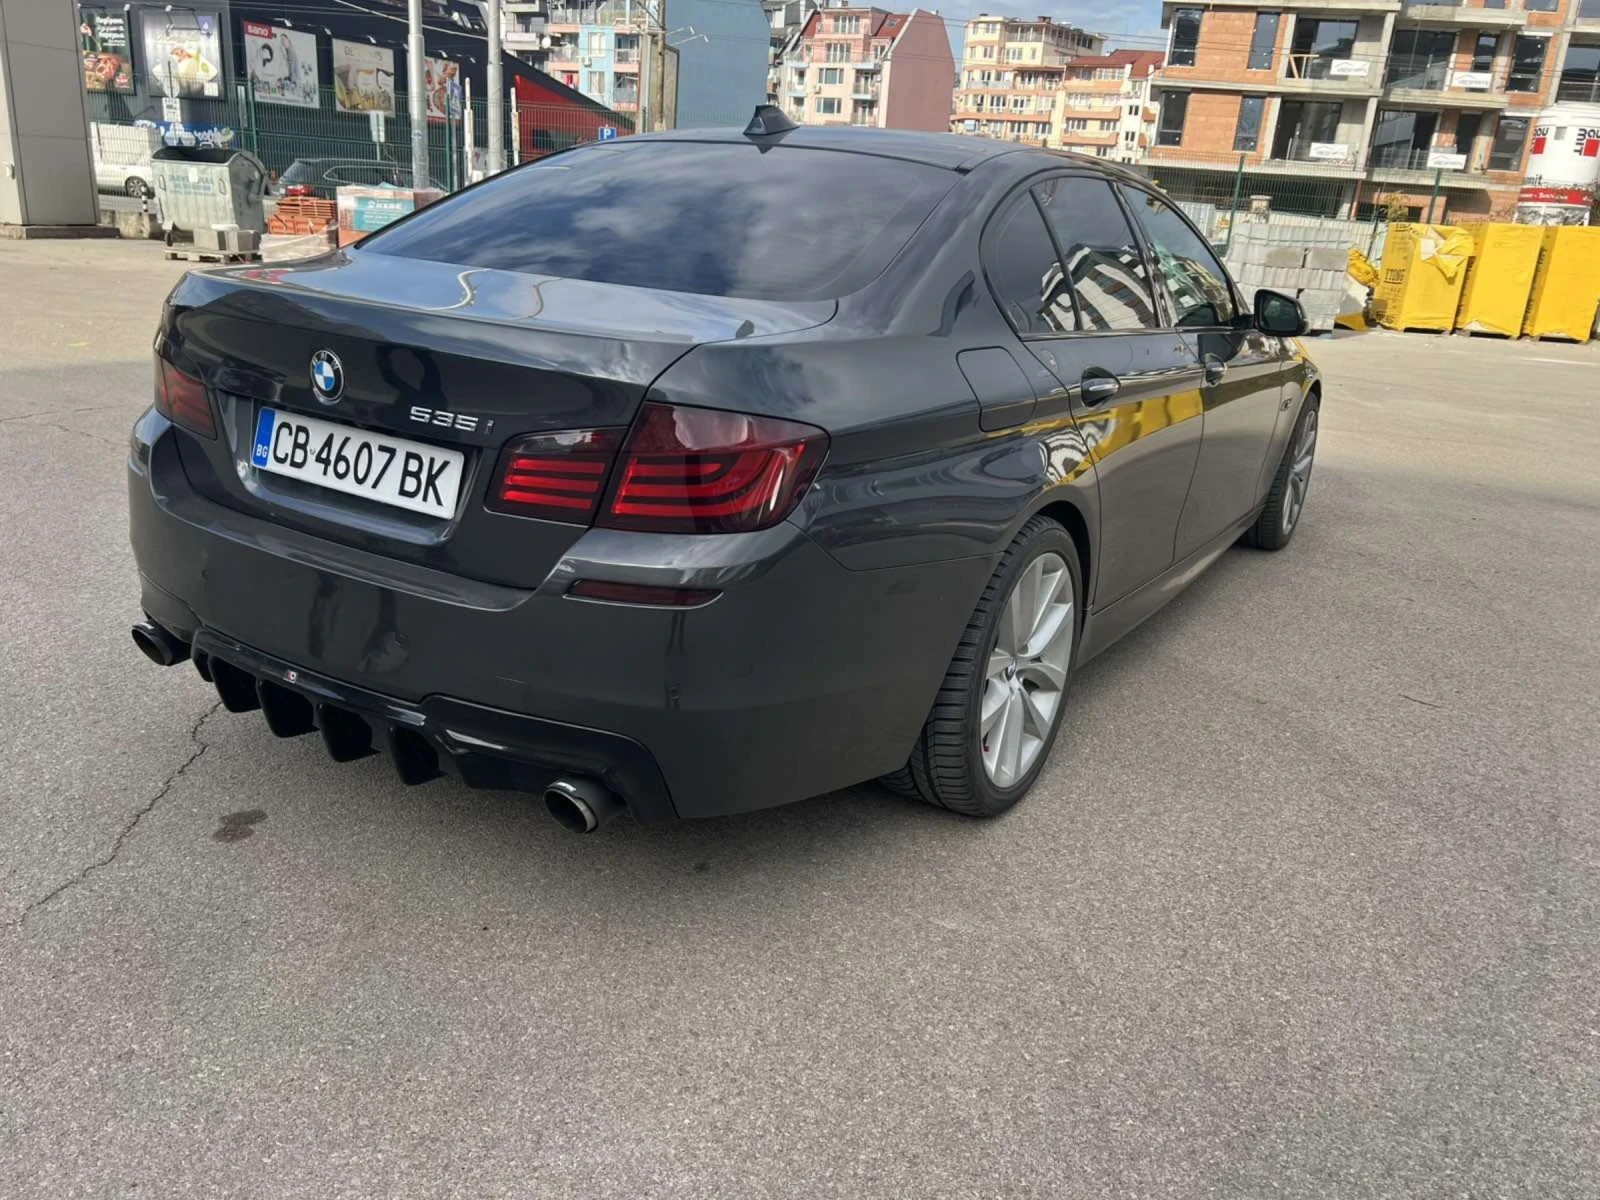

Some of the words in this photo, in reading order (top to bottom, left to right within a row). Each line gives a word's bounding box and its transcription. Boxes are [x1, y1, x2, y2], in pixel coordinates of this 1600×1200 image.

[247, 25, 269, 37] sano
[256, 444, 268, 458] BG
[273, 421, 310, 469] CB
[315, 432, 397, 489] 4607
[398, 451, 450, 507] BK
